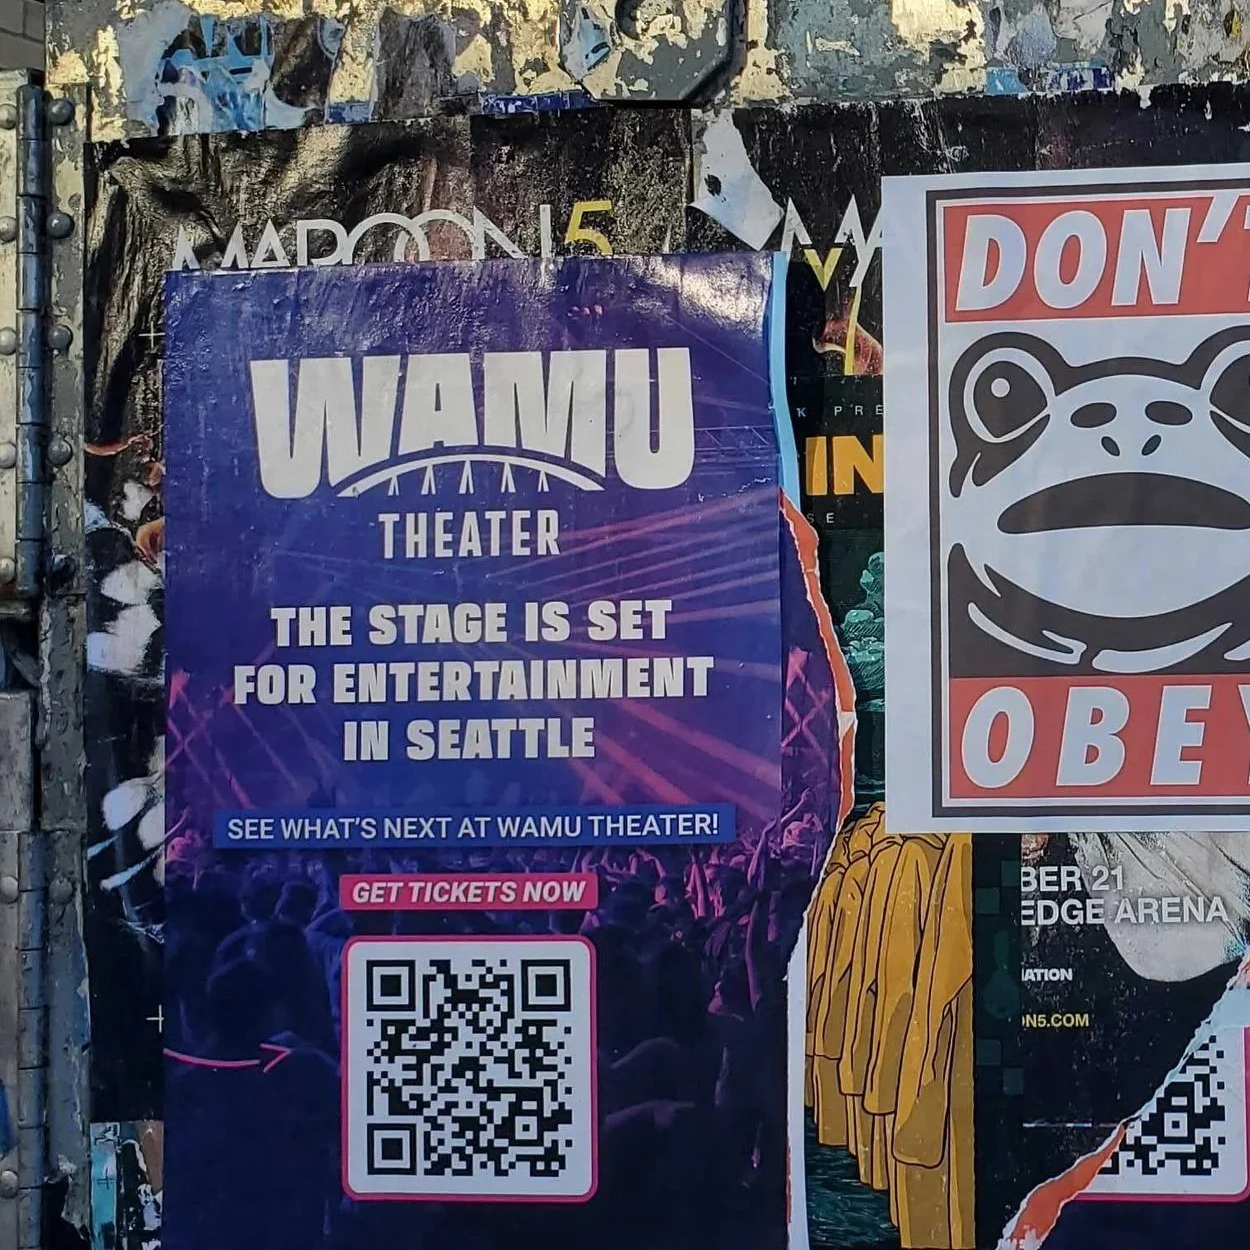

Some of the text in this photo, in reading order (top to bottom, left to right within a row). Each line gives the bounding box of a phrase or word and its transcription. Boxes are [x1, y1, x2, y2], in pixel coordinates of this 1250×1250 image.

[250, 347, 695, 499] WAMU
[379, 509, 560, 559] THEATER
[271, 600, 672, 647] THE STAGE IS SET
[233, 656, 715, 705] FOR ENTERTAINMENT
[343, 717, 596, 761] IN SEATTLE
[227, 813, 719, 841] SEE WHAT'S NEXT AT WAMU THEATER!
[352, 880, 587, 903] GET TICKETS NOW
[1021, 865, 1124, 892] BER 21
[1021, 896, 1230, 925] EDGE ARENA
[1021, 1013, 1090, 1028] N5.COM
